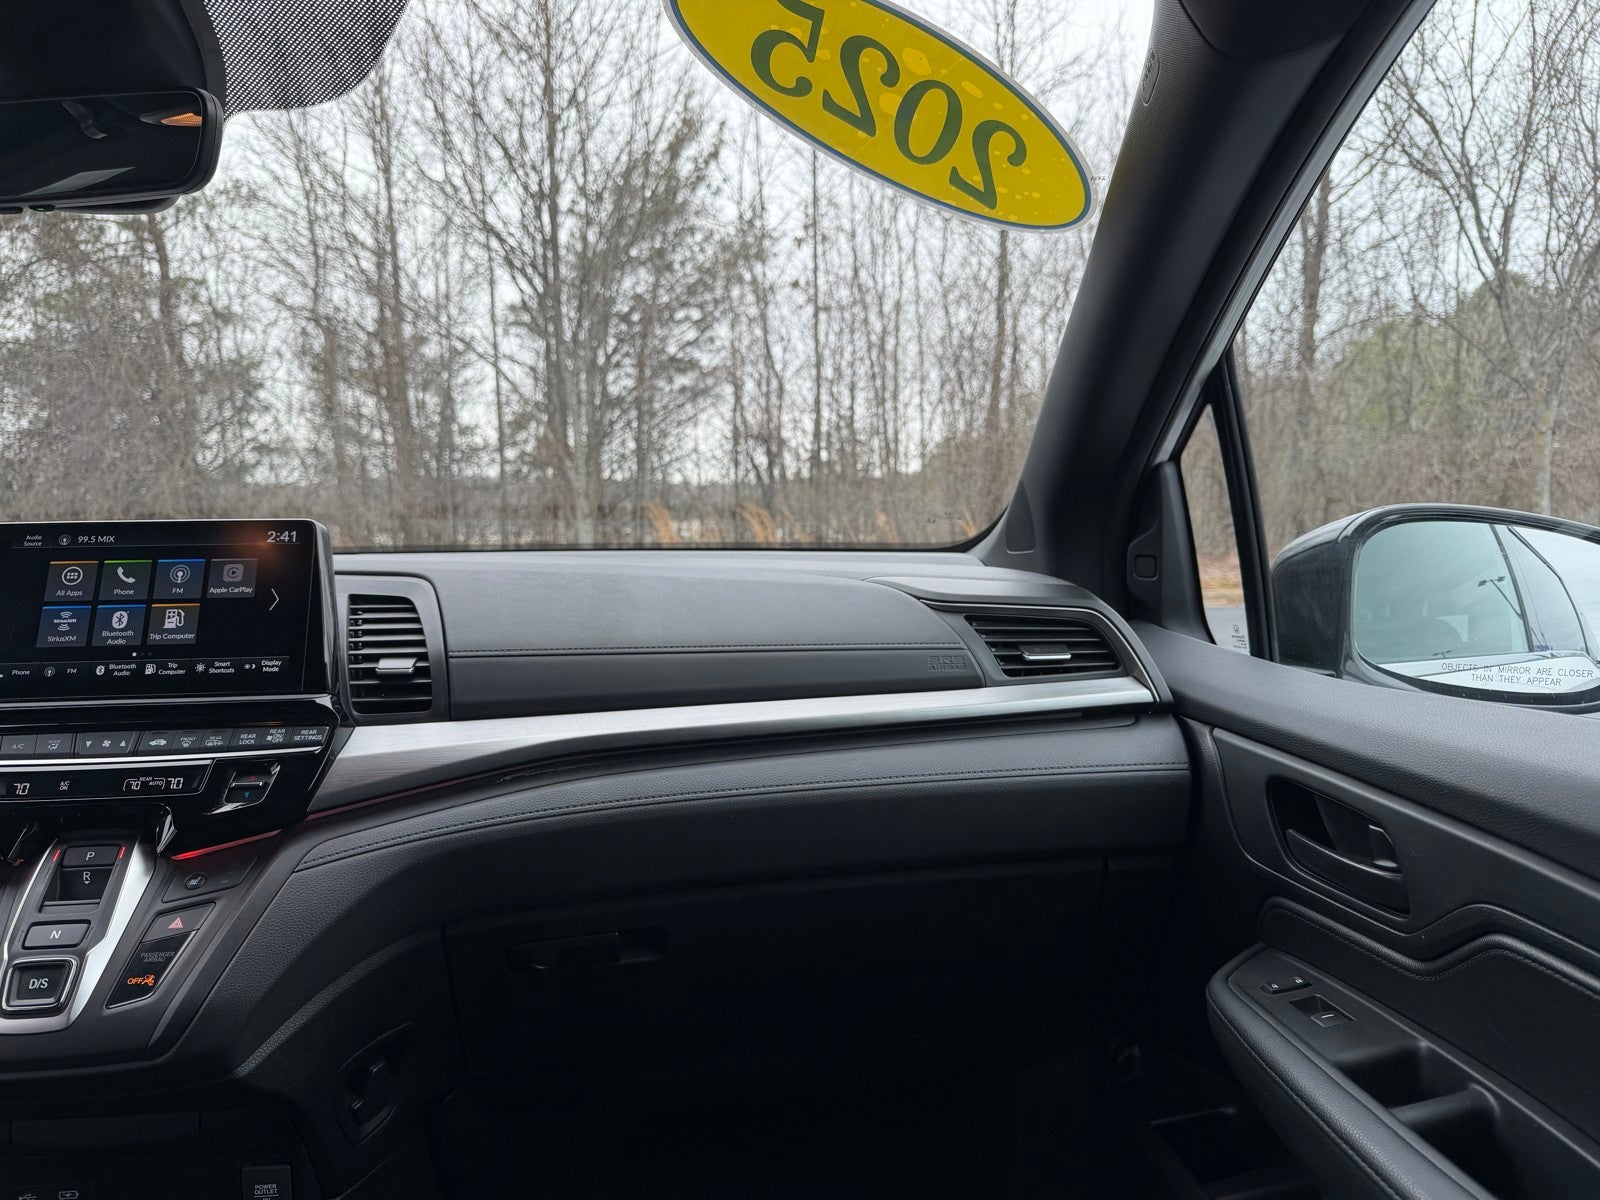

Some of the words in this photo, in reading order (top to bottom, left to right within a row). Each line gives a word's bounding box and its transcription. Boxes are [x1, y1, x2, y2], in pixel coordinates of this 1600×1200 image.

[97, 535, 116, 543] MIX
[267, 530, 297, 543] 2:41
[228, 586, 254, 594] CarPlay
[149, 633, 162, 641] Trip
[162, 633, 196, 641] Computer
[1441, 663, 1478, 671] OBJECTS
[1484, 665, 1492, 673] IN
[1498, 666, 1531, 675] MIRROR
[1536, 668, 1553, 676] ARE
[1558, 669, 1593, 678] CLOSER
[1472, 673, 1494, 682] THAN
[1499, 675, 1522, 683] THEY
[1526, 677, 1562, 686] APPEAR
[130, 781, 141, 790] 70
[167, 778, 183, 789] 70
[13, 783, 30, 795] 70
[85, 852, 95, 861] P
[83, 871, 91, 881] R
[50, 930, 61, 939] N
[28, 978, 49, 990] D/S
